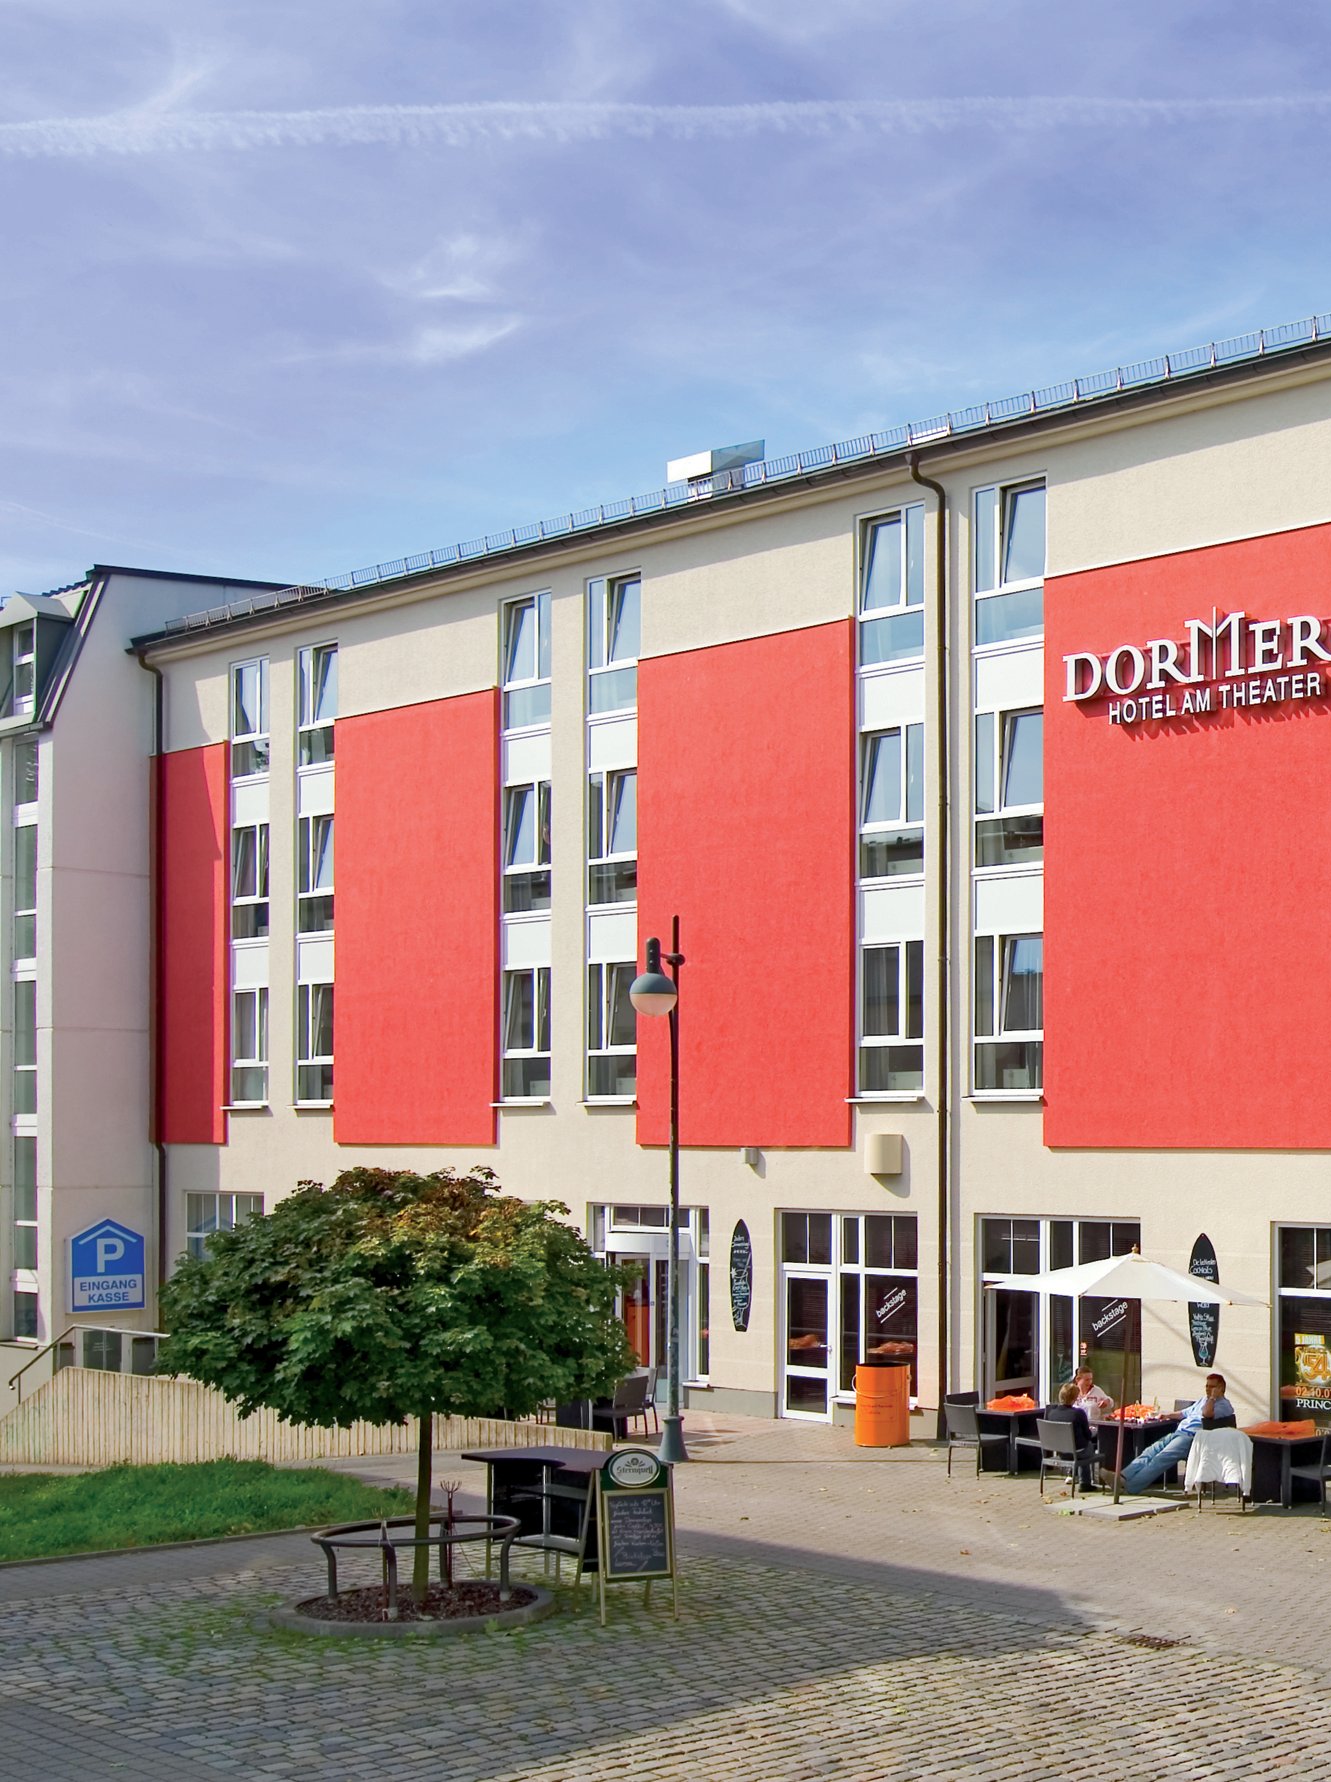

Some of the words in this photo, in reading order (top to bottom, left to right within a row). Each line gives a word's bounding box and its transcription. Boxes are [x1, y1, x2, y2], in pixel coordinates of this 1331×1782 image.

[1109, 694, 1176, 724] HOTEL
[1181, 688, 1211, 714] AM
[1218, 672, 1321, 709] THEATER
[97, 1238, 125, 1273] P
[80, 1279, 137, 1292] EINGANG
[88, 1292, 129, 1304] KASSE
[876, 1289, 907, 1318] backstage
[1091, 1301, 1128, 1331] backstage
